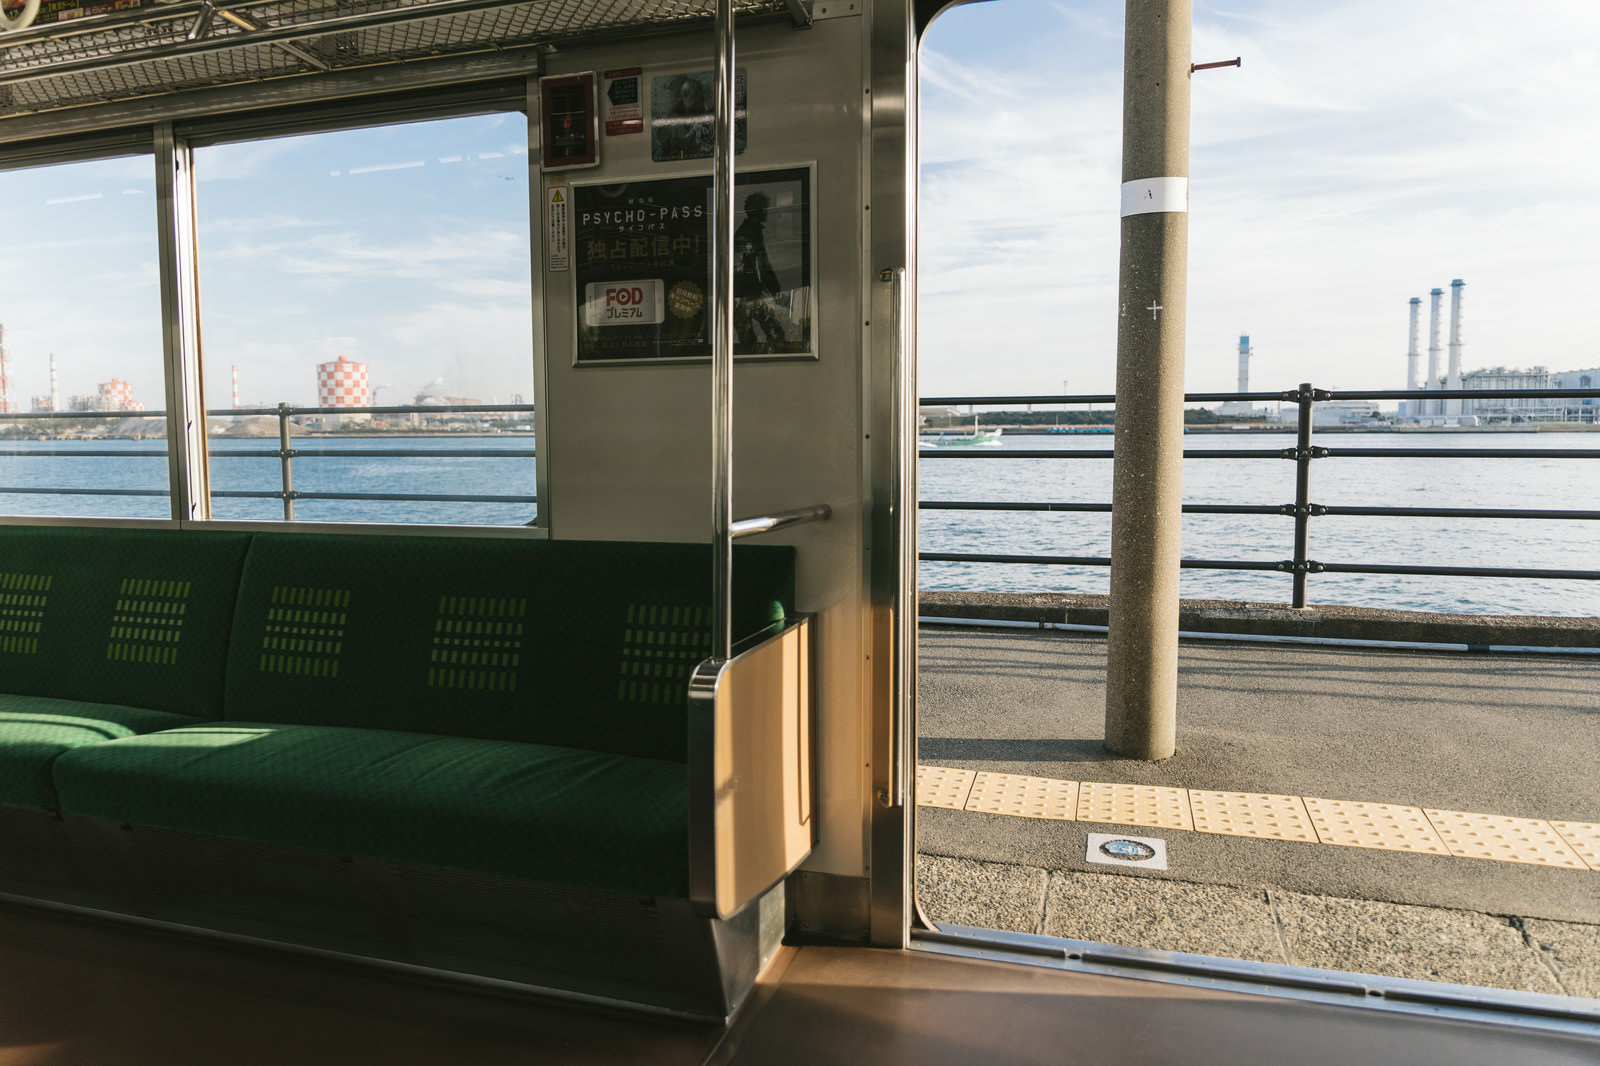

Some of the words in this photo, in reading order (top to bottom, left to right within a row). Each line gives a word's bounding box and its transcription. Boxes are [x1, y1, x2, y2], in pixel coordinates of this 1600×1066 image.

[582, 205, 703, 226] PSYCHO-PASS
[606, 287, 643, 307] FOD
[606, 307, 643, 319] プレミアム
